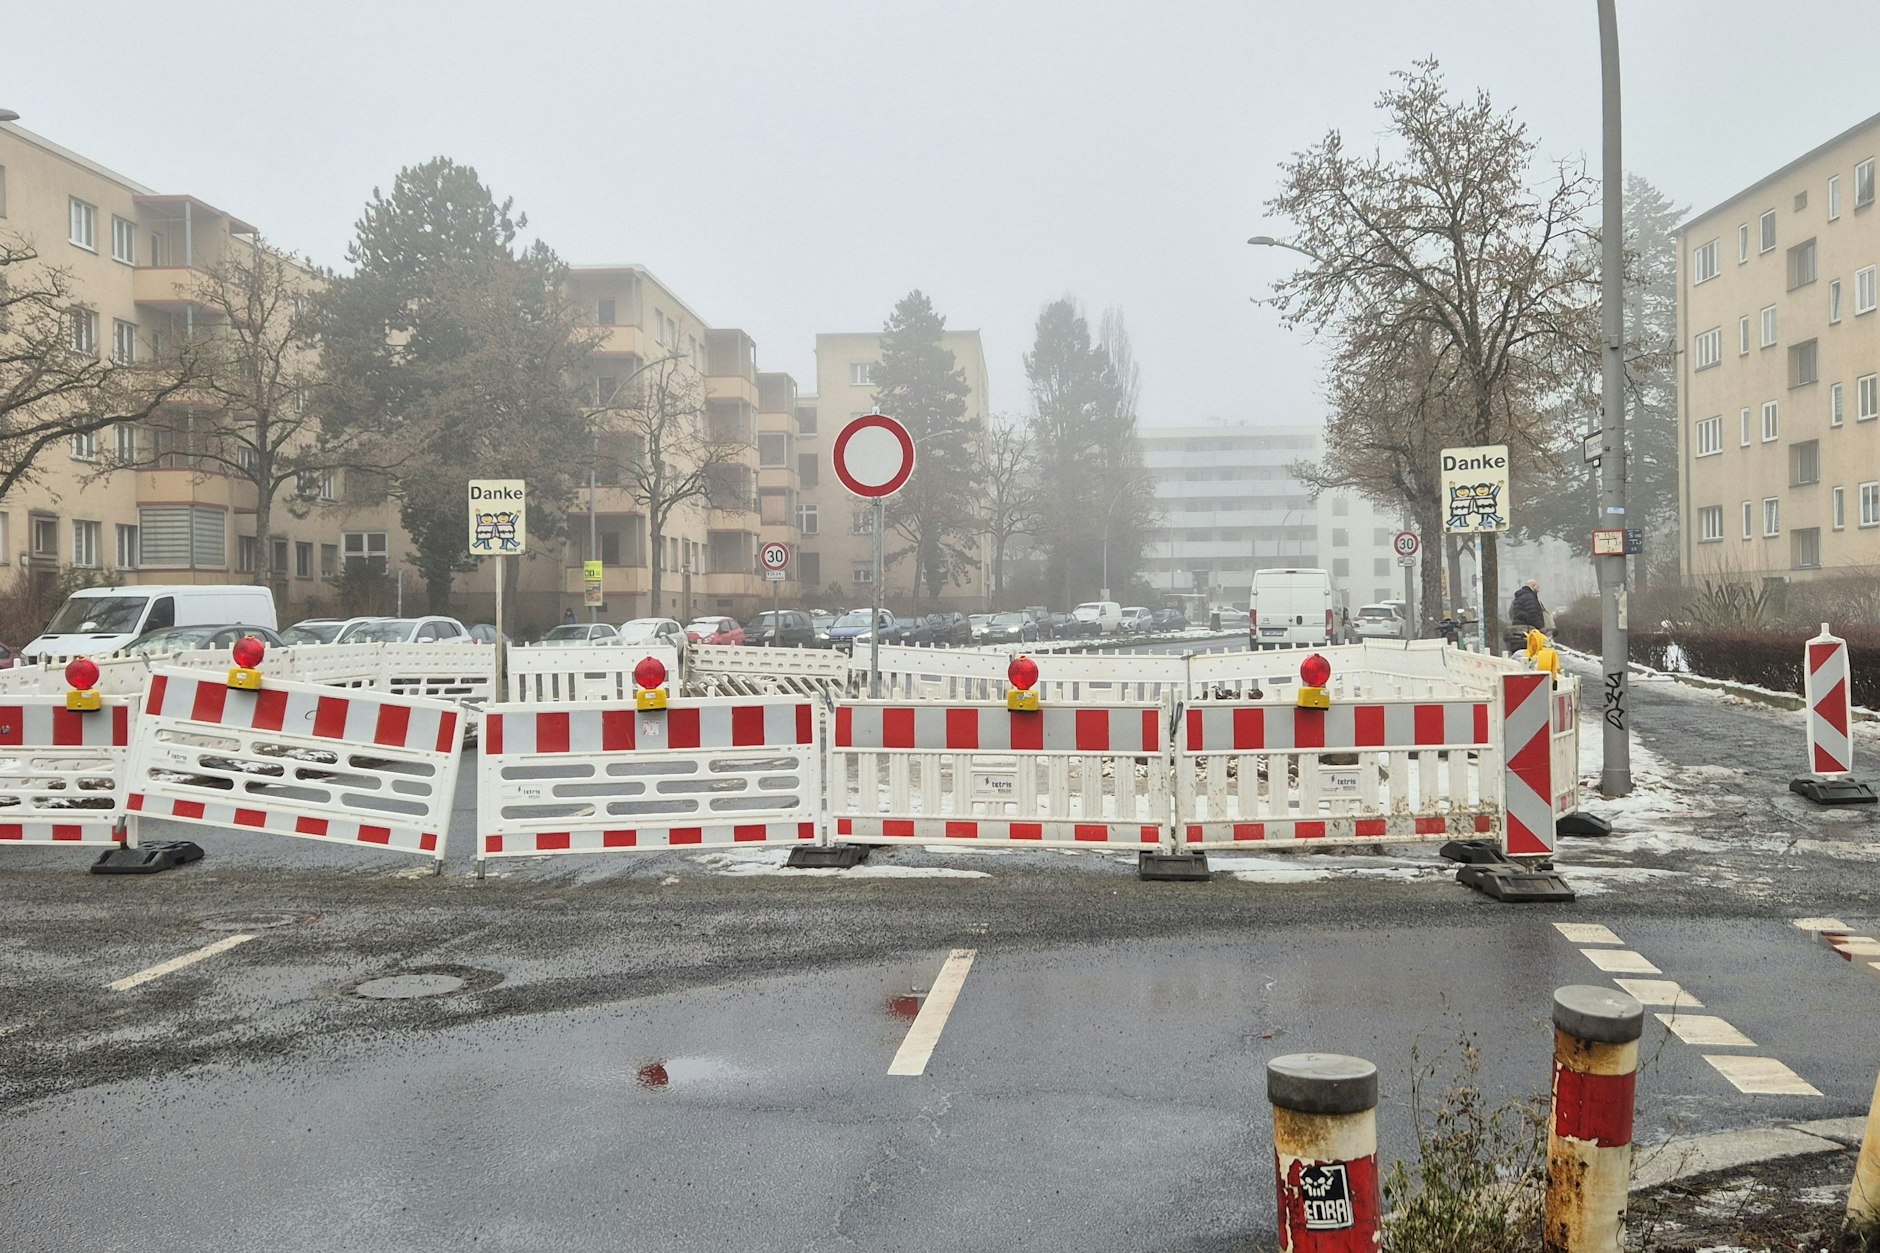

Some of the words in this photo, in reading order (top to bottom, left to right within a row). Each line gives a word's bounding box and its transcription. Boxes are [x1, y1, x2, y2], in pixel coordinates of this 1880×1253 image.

[1443, 454, 1506, 471] Danke
[471, 486, 523, 500] Danke
[1399, 538, 1414, 550] 30
[767, 549, 783, 563] 30
